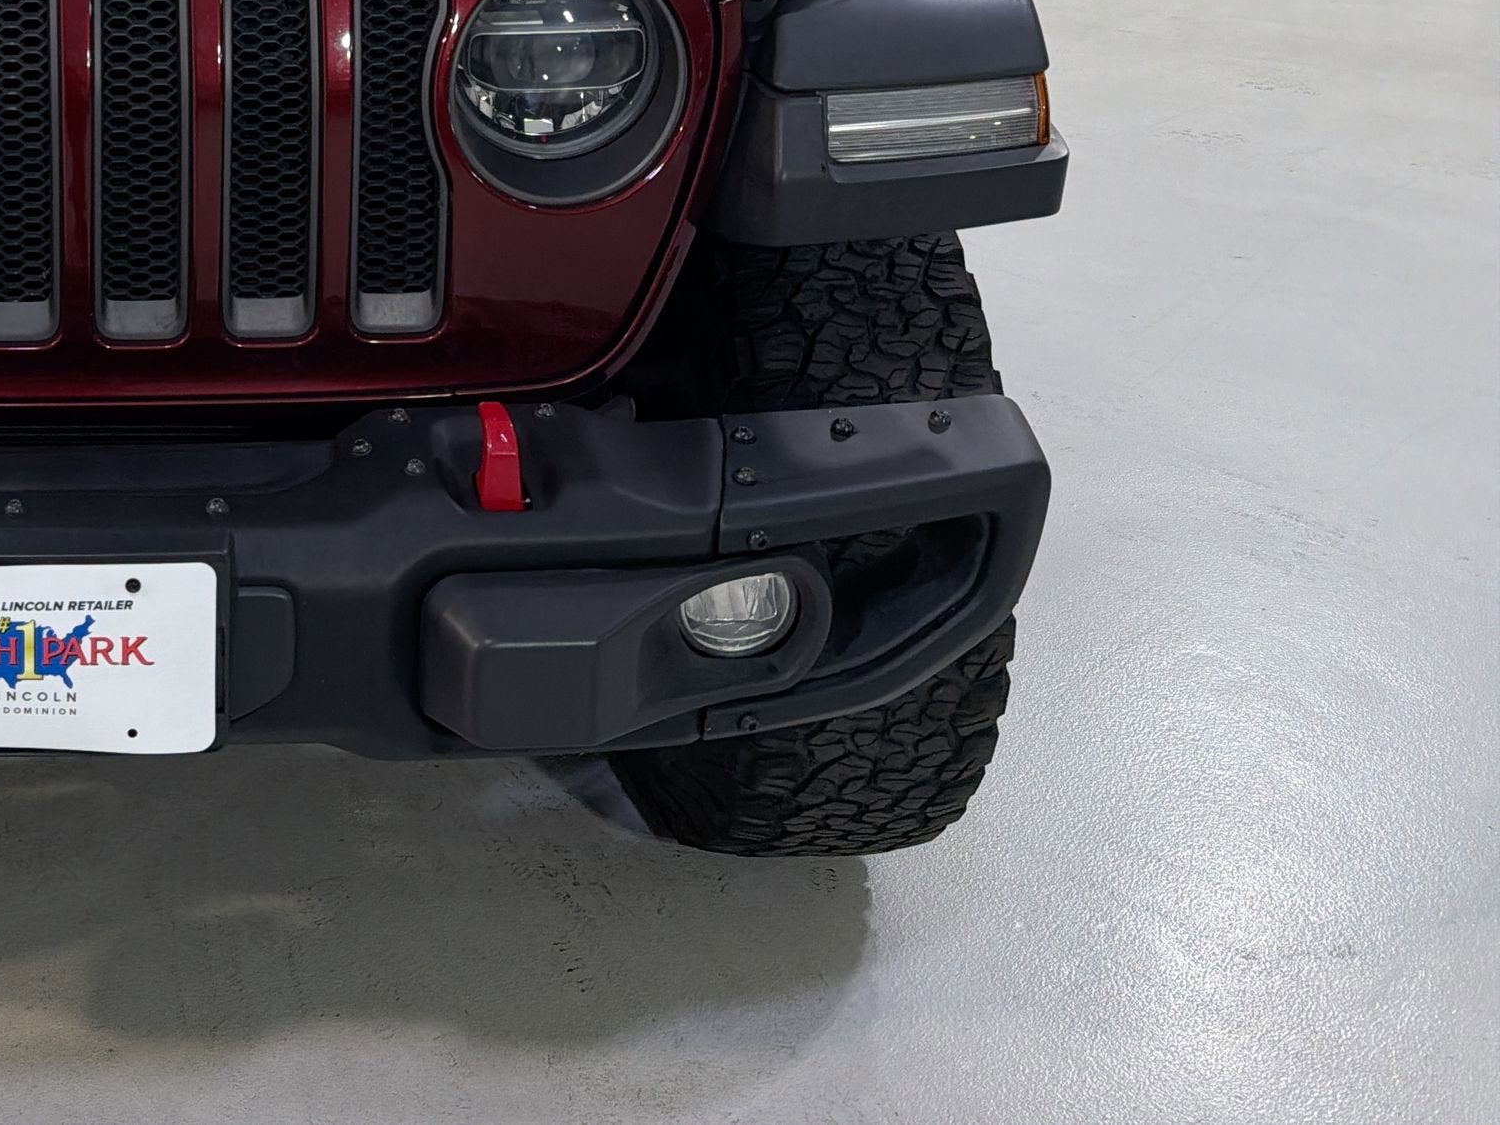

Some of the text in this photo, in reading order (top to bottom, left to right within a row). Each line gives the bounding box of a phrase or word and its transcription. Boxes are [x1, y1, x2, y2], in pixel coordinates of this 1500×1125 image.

[1, 601, 64, 612] LINCOLN
[67, 600, 134, 611] RETAILER
[42, 635, 155, 666] PARK
[3, 706, 77, 716] DOMINION
